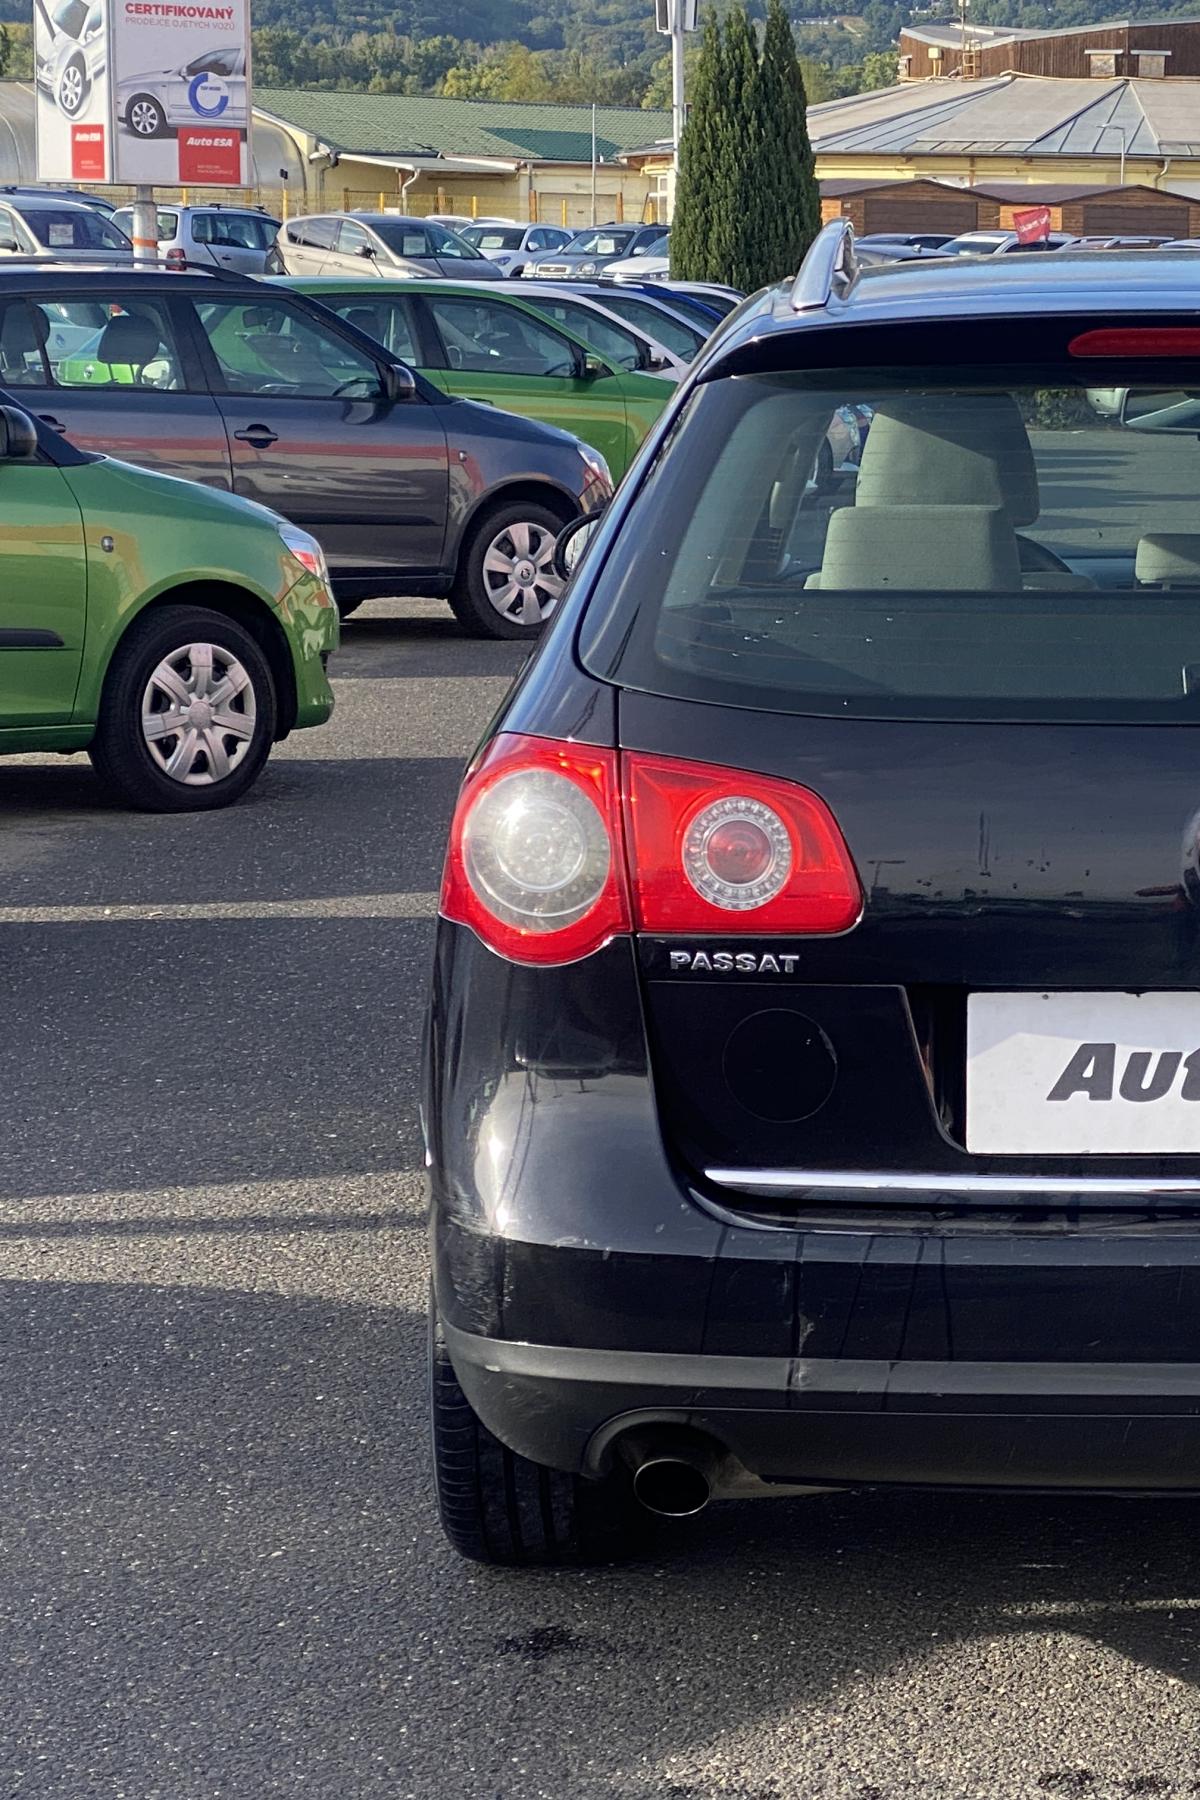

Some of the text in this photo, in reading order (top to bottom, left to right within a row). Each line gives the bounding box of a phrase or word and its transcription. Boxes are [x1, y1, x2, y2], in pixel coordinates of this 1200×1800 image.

[125, 3, 234, 19] CERTIFIKOVANÝ
[125, 17, 171, 27] PRODEJCE
[186, 136, 233, 147] Auto ESA
[669, 951, 800, 973] PASSAT
